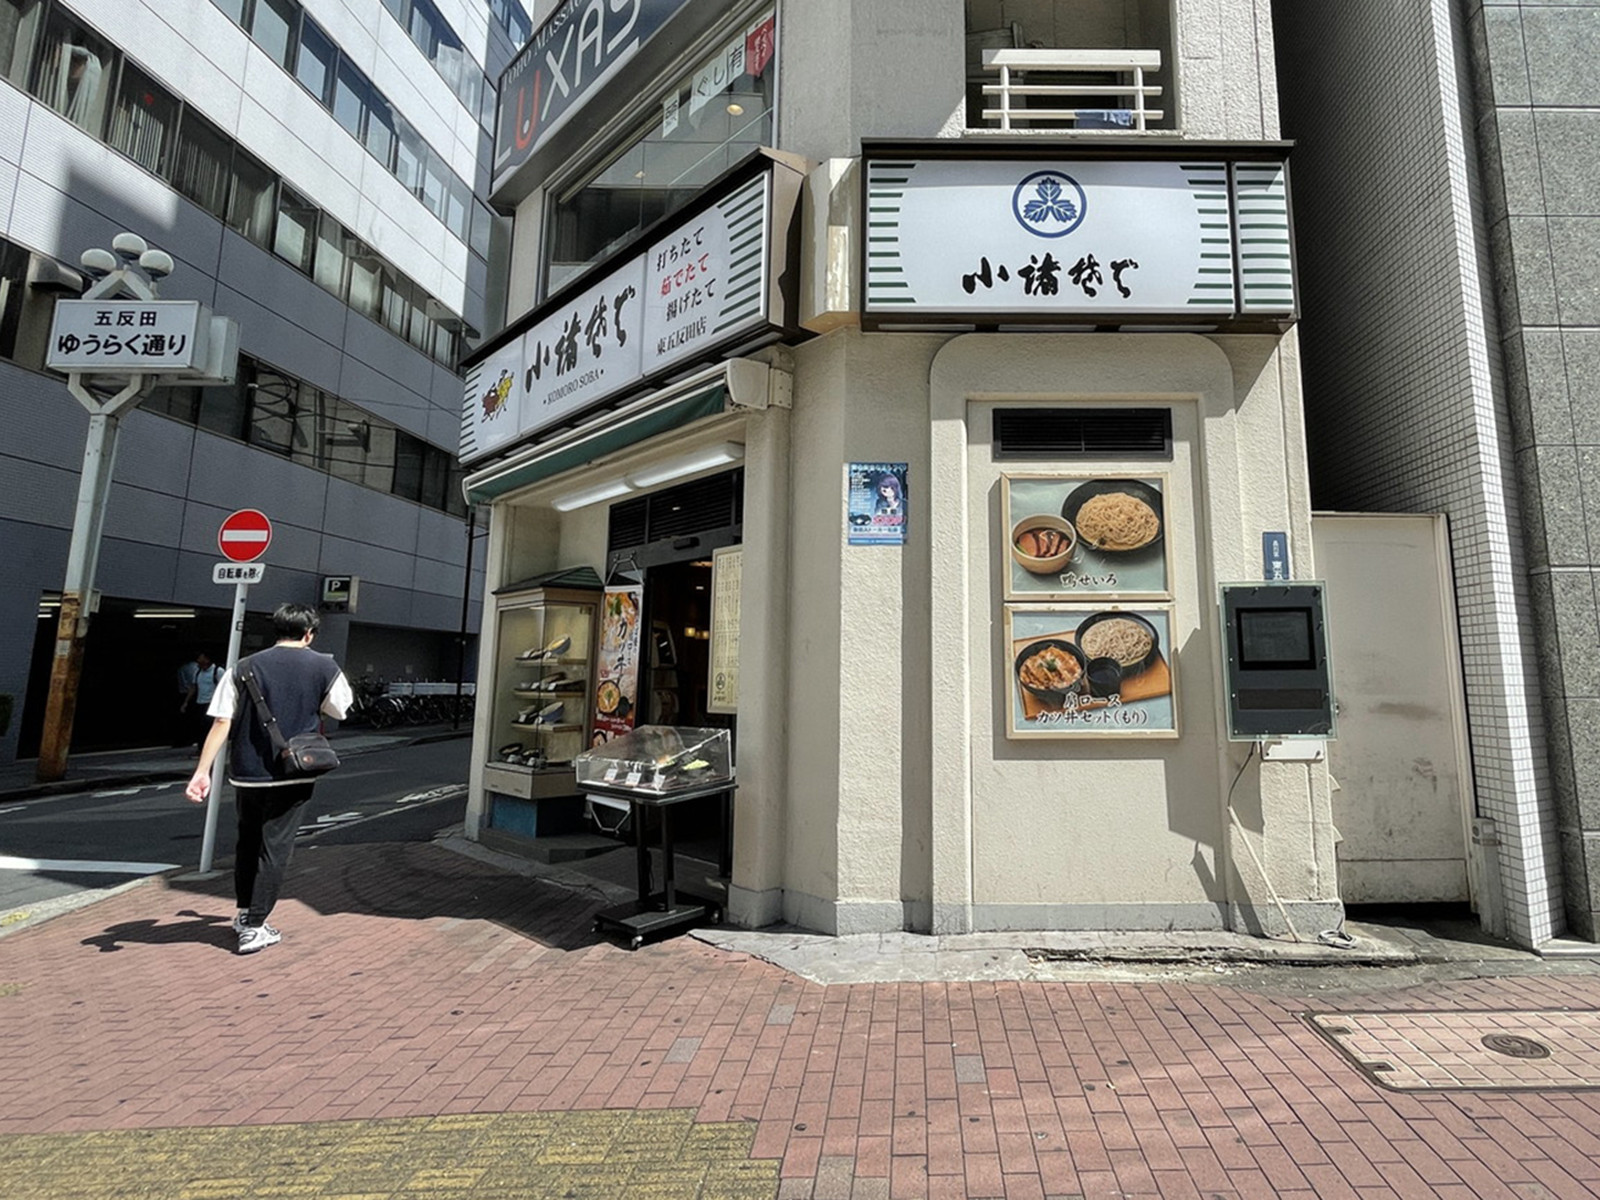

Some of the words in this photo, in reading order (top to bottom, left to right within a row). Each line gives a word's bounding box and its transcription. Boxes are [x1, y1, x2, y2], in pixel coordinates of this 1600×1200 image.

[656, 226, 705, 272] 打ちたて
[660, 252, 710, 297] 茹でたて
[94, 311, 157, 326] 五反田
[665, 278, 717, 322] 揚げたて
[58, 333, 186, 356] ゆうらく通り
[656, 315, 708, 357] 東五反田店
[547, 378, 579, 405] KOMORO
[579, 368, 600, 389] SOBA
[217, 567, 261, 579] 自転車を除く
[331, 580, 341, 591] P
